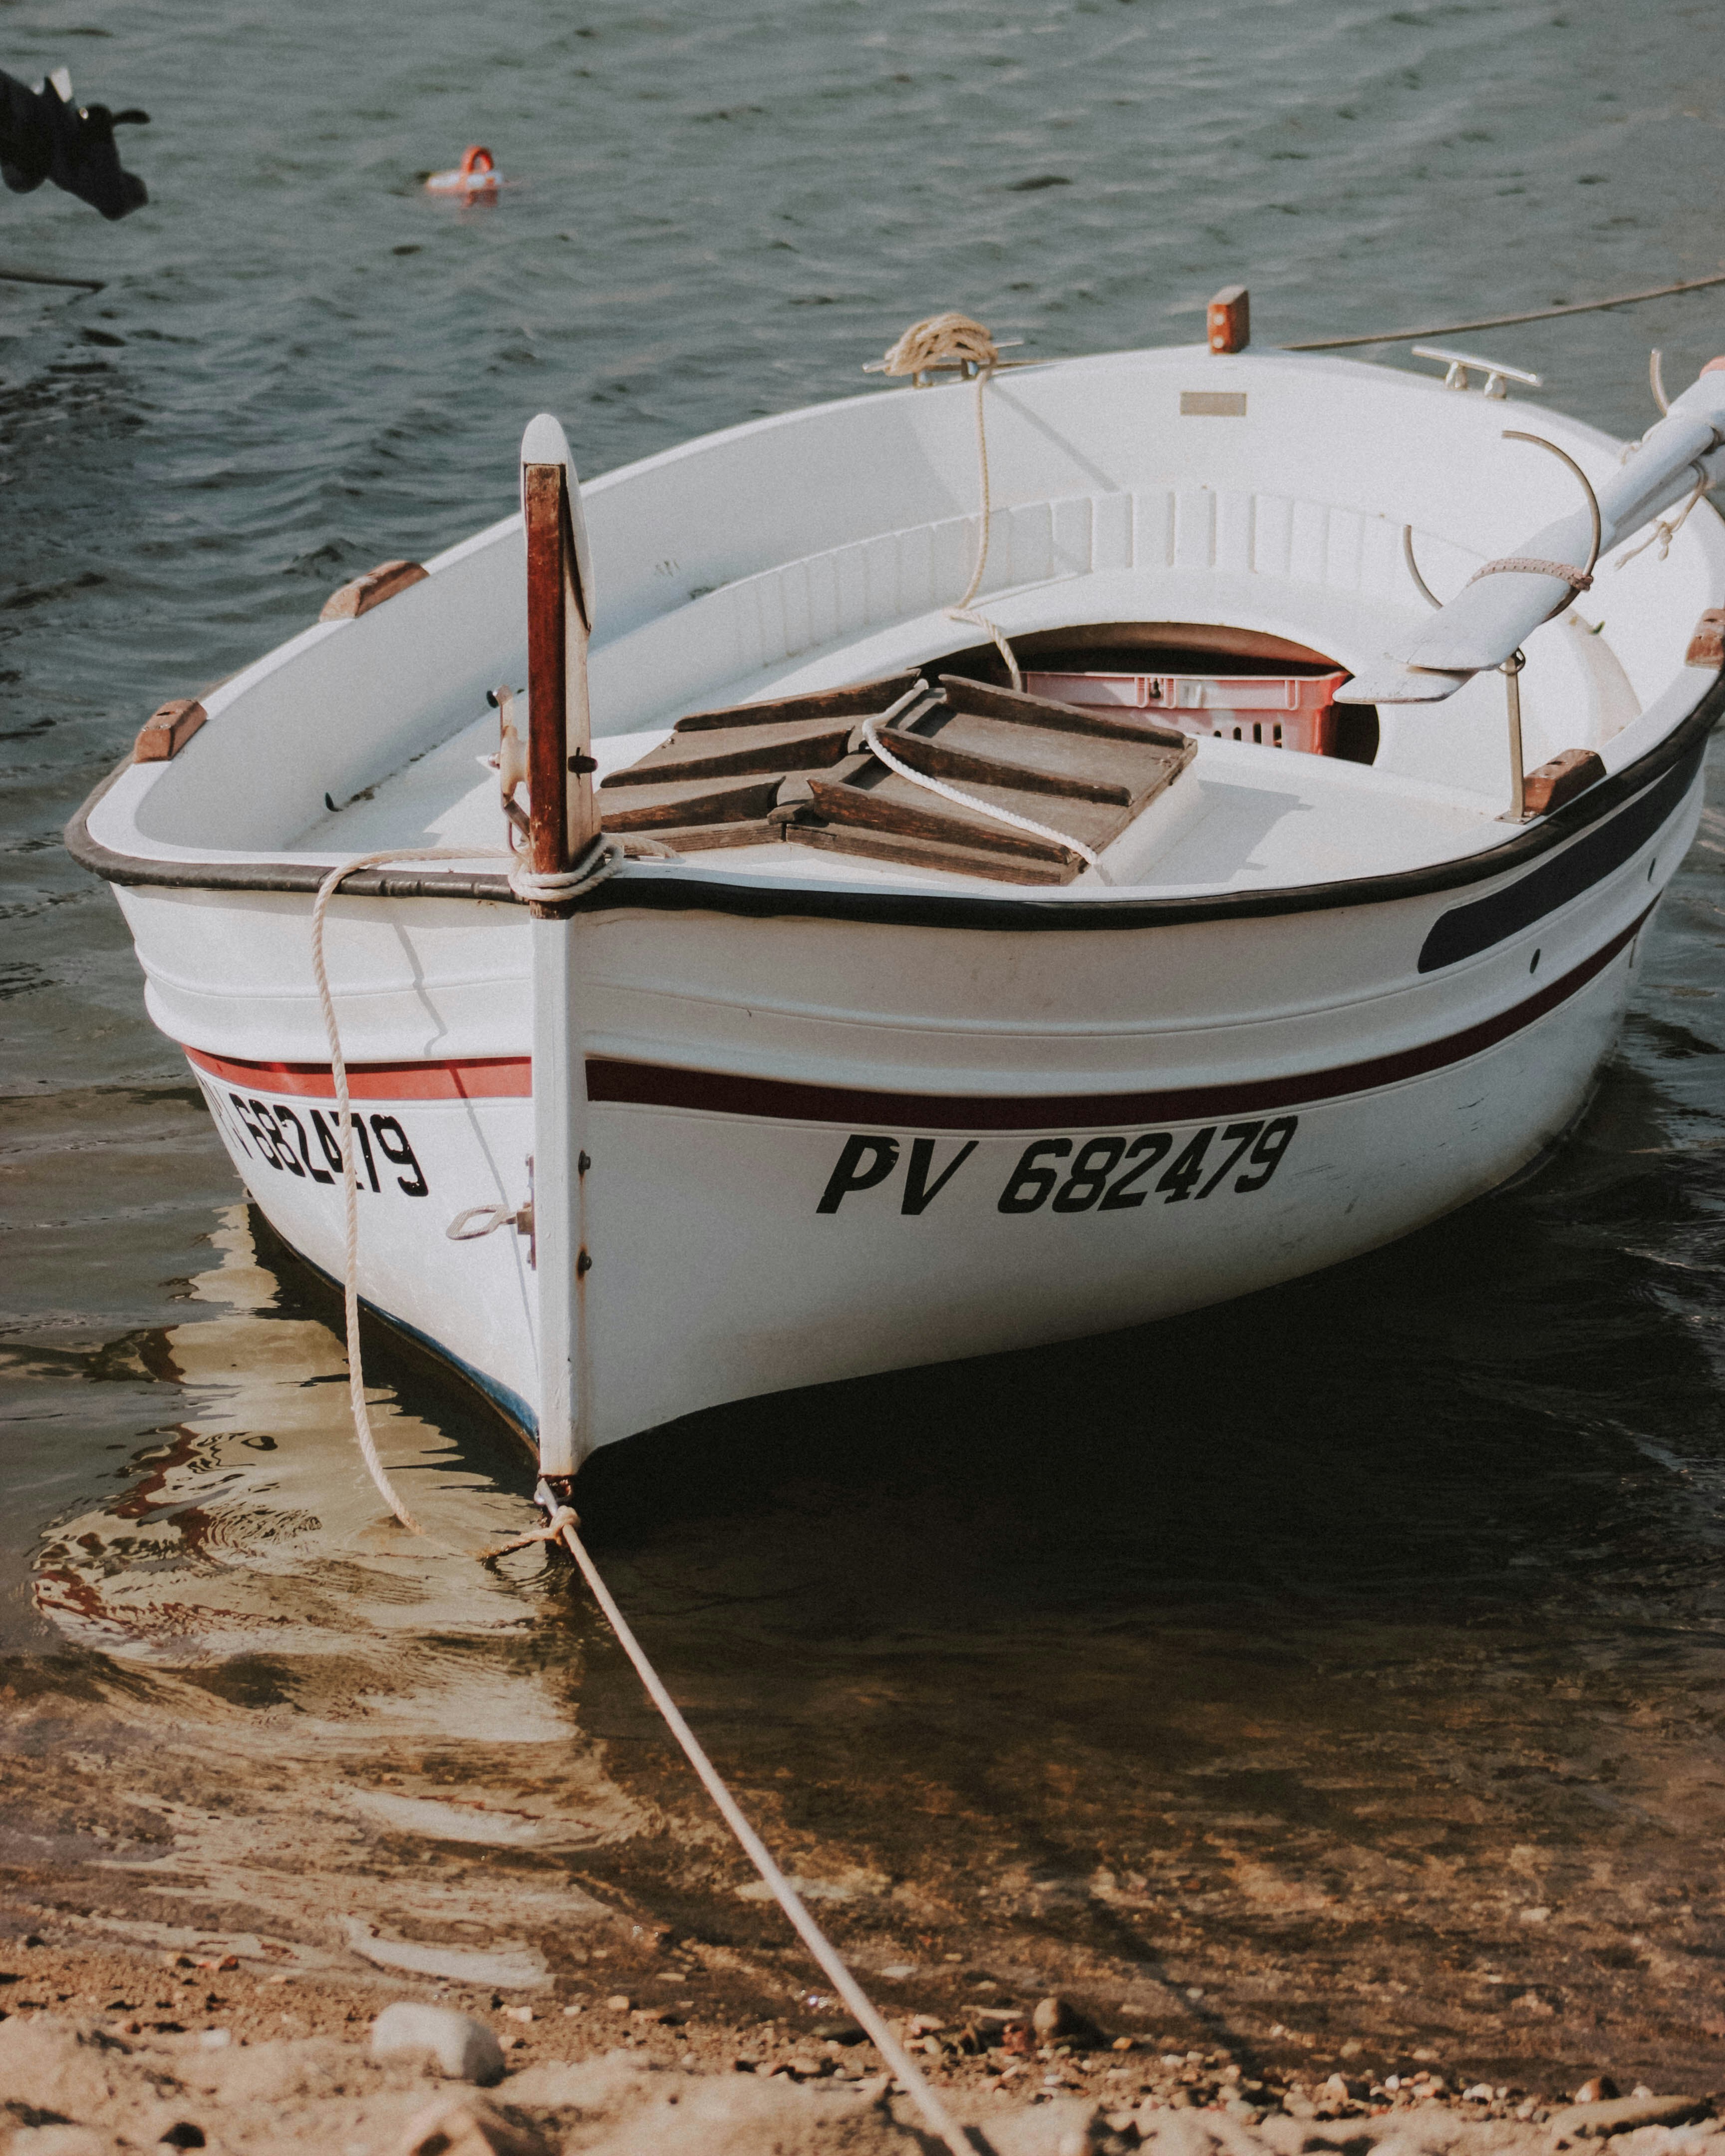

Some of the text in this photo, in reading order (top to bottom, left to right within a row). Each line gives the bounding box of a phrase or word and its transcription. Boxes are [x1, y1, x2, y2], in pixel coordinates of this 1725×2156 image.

[229, 1092, 429, 1197] 682479
[816, 1115, 1298, 1215] PV 682479
